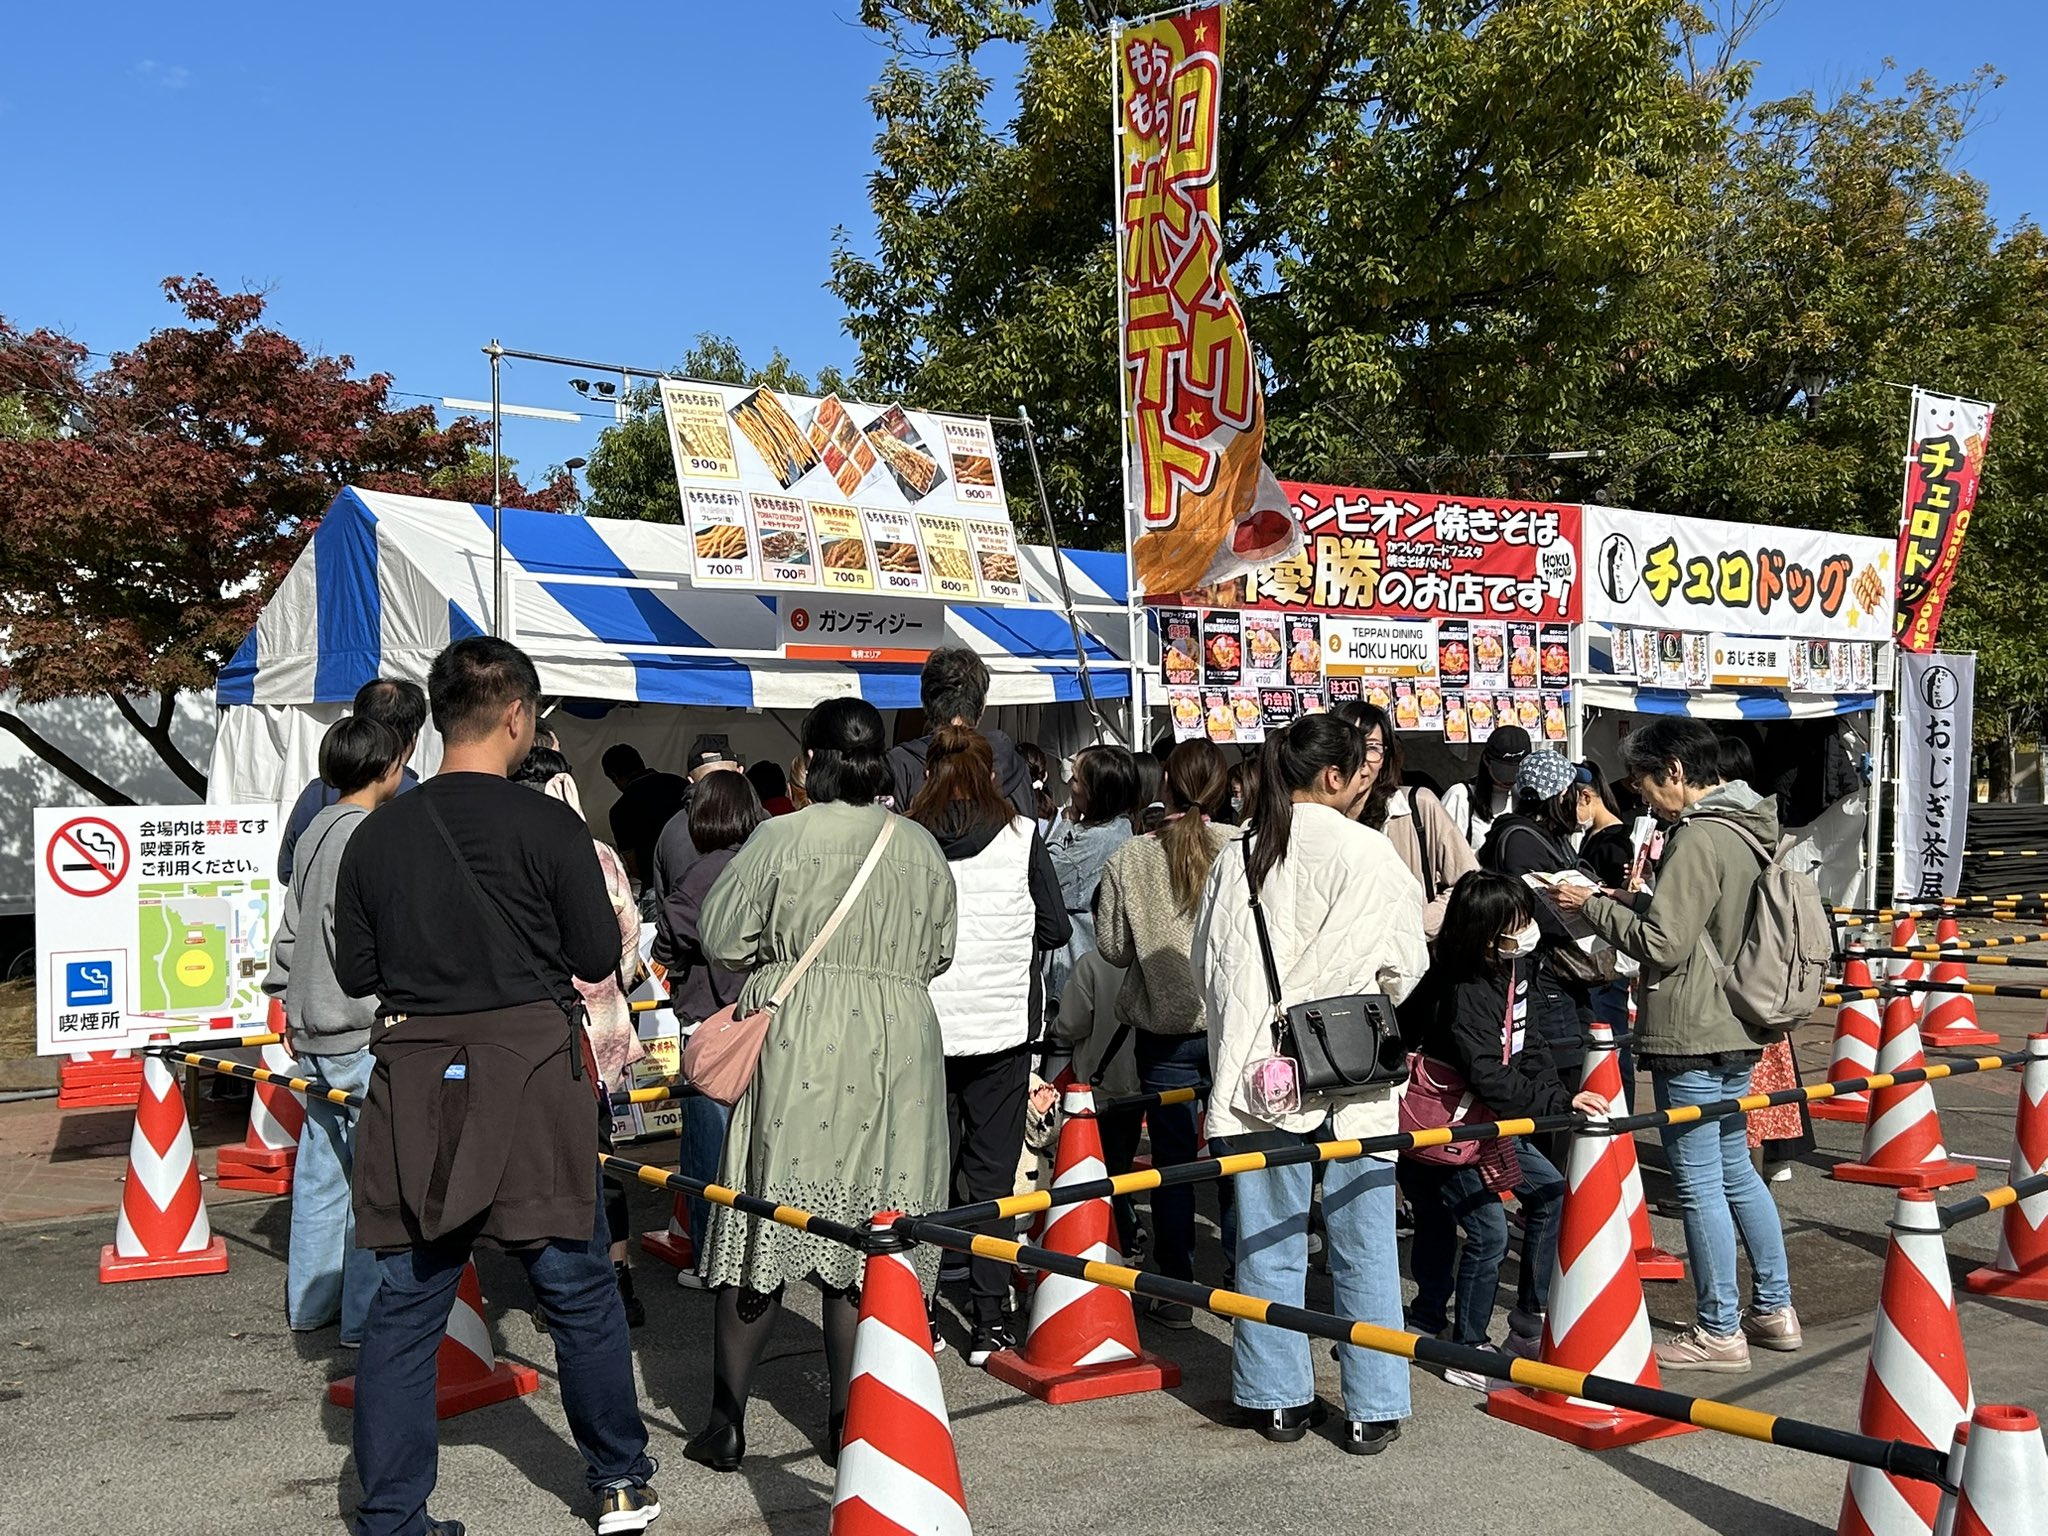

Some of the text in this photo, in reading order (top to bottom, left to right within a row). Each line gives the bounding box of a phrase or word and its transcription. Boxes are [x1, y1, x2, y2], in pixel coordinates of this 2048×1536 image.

[669, 391, 721, 408] もちもちポテト
[691, 458, 728, 473] 900円
[688, 491, 741, 506] もちもちポテト
[965, 489, 993, 499] 900円
[753, 496, 802, 513] もちもちポテト
[811, 505, 858, 520] もちもちポテト
[866, 511, 910, 526] もちもちポテト
[1292, 494, 1560, 546] ンピオン焼きそば
[919, 517, 962, 532] もちもちポテト
[969, 523, 1010, 538] もちもちポテト
[1386, 541, 1483, 558] かつしかフードフェスタ
[1386, 554, 1452, 570] 焼きそばバトル
[1542, 553, 1570, 568] HOKU
[707, 564, 743, 575] 700円
[773, 568, 807, 579] 700円
[833, 571, 865, 583] 700円
[1642, 536, 1852, 618] チュロドッグ
[889, 576, 919, 587] 800円
[941, 580, 970, 592] 800円
[990, 585, 1019, 596] 900円
[795, 610, 923, 635] 3 ガンディジー
[1352, 627, 1423, 639] TEPPAN DINING
[1331, 638, 1427, 660] 2 HOKU HOKU
[1727, 650, 1776, 668] おじぎ茶屋
[1330, 680, 1359, 694] 注文口
[1262, 692, 1293, 706] お会計
[1917, 714, 1953, 899] おじぎ茶屋
[140, 819, 269, 837] 会場内は禁煙です
[140, 840, 206, 857] 喫煙所を
[142, 860, 260, 876] ご利用ください。
[59, 1011, 120, 1032] 喫煙所
